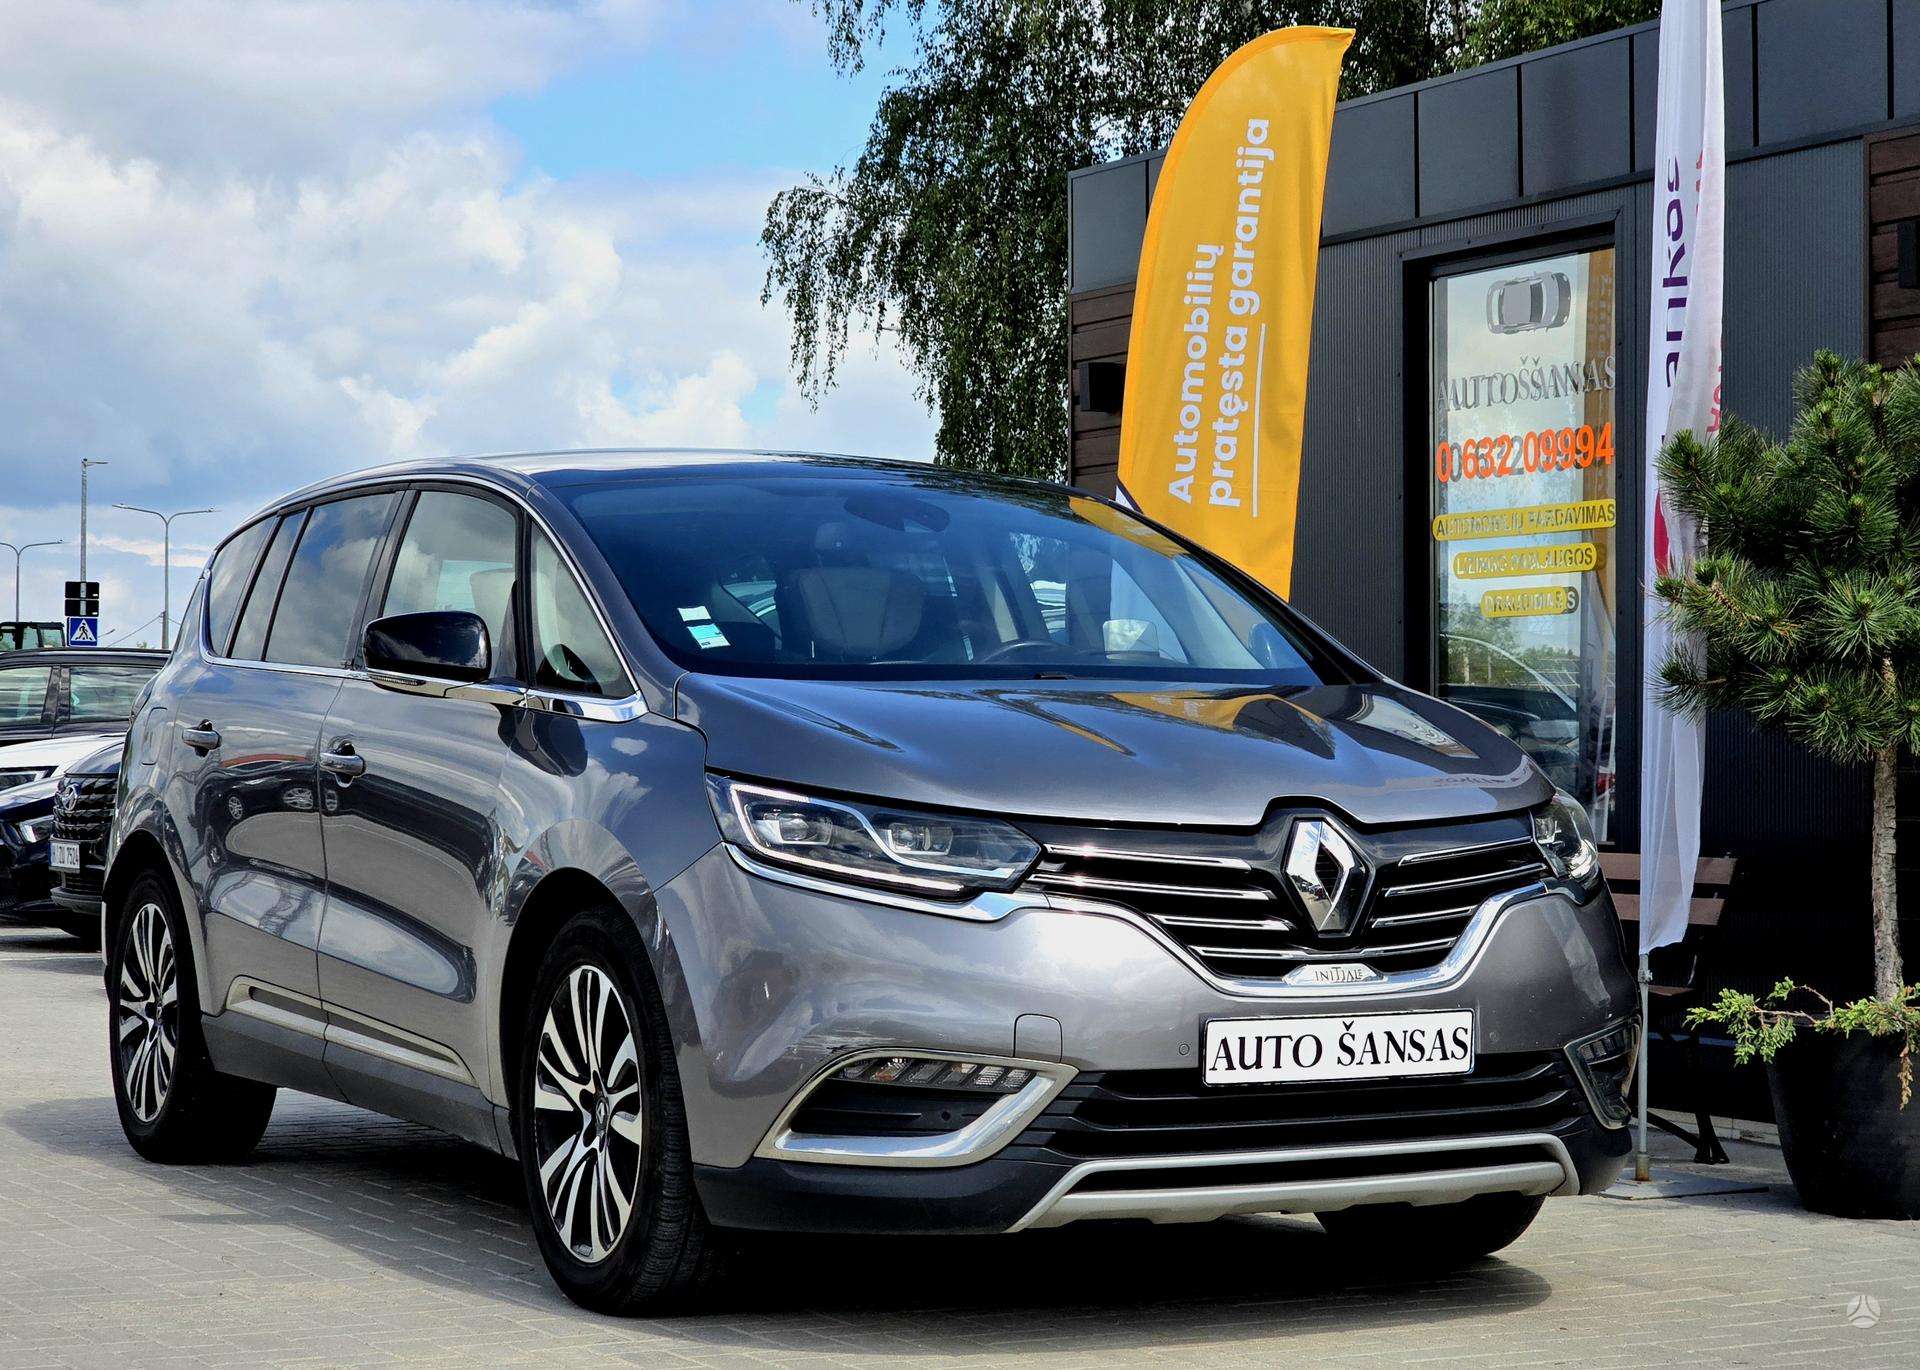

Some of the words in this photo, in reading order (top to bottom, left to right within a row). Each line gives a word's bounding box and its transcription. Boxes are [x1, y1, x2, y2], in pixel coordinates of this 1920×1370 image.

[1228, 118, 1276, 316] garantija
[1168, 243, 1224, 505] Automobilių
[1208, 326, 1249, 508] pratęsta
[1208, 1034, 1323, 1072] AUTO
[1336, 1020, 1470, 1067] ŠANSAS
[1314, 966, 1364, 983] INITIALE
